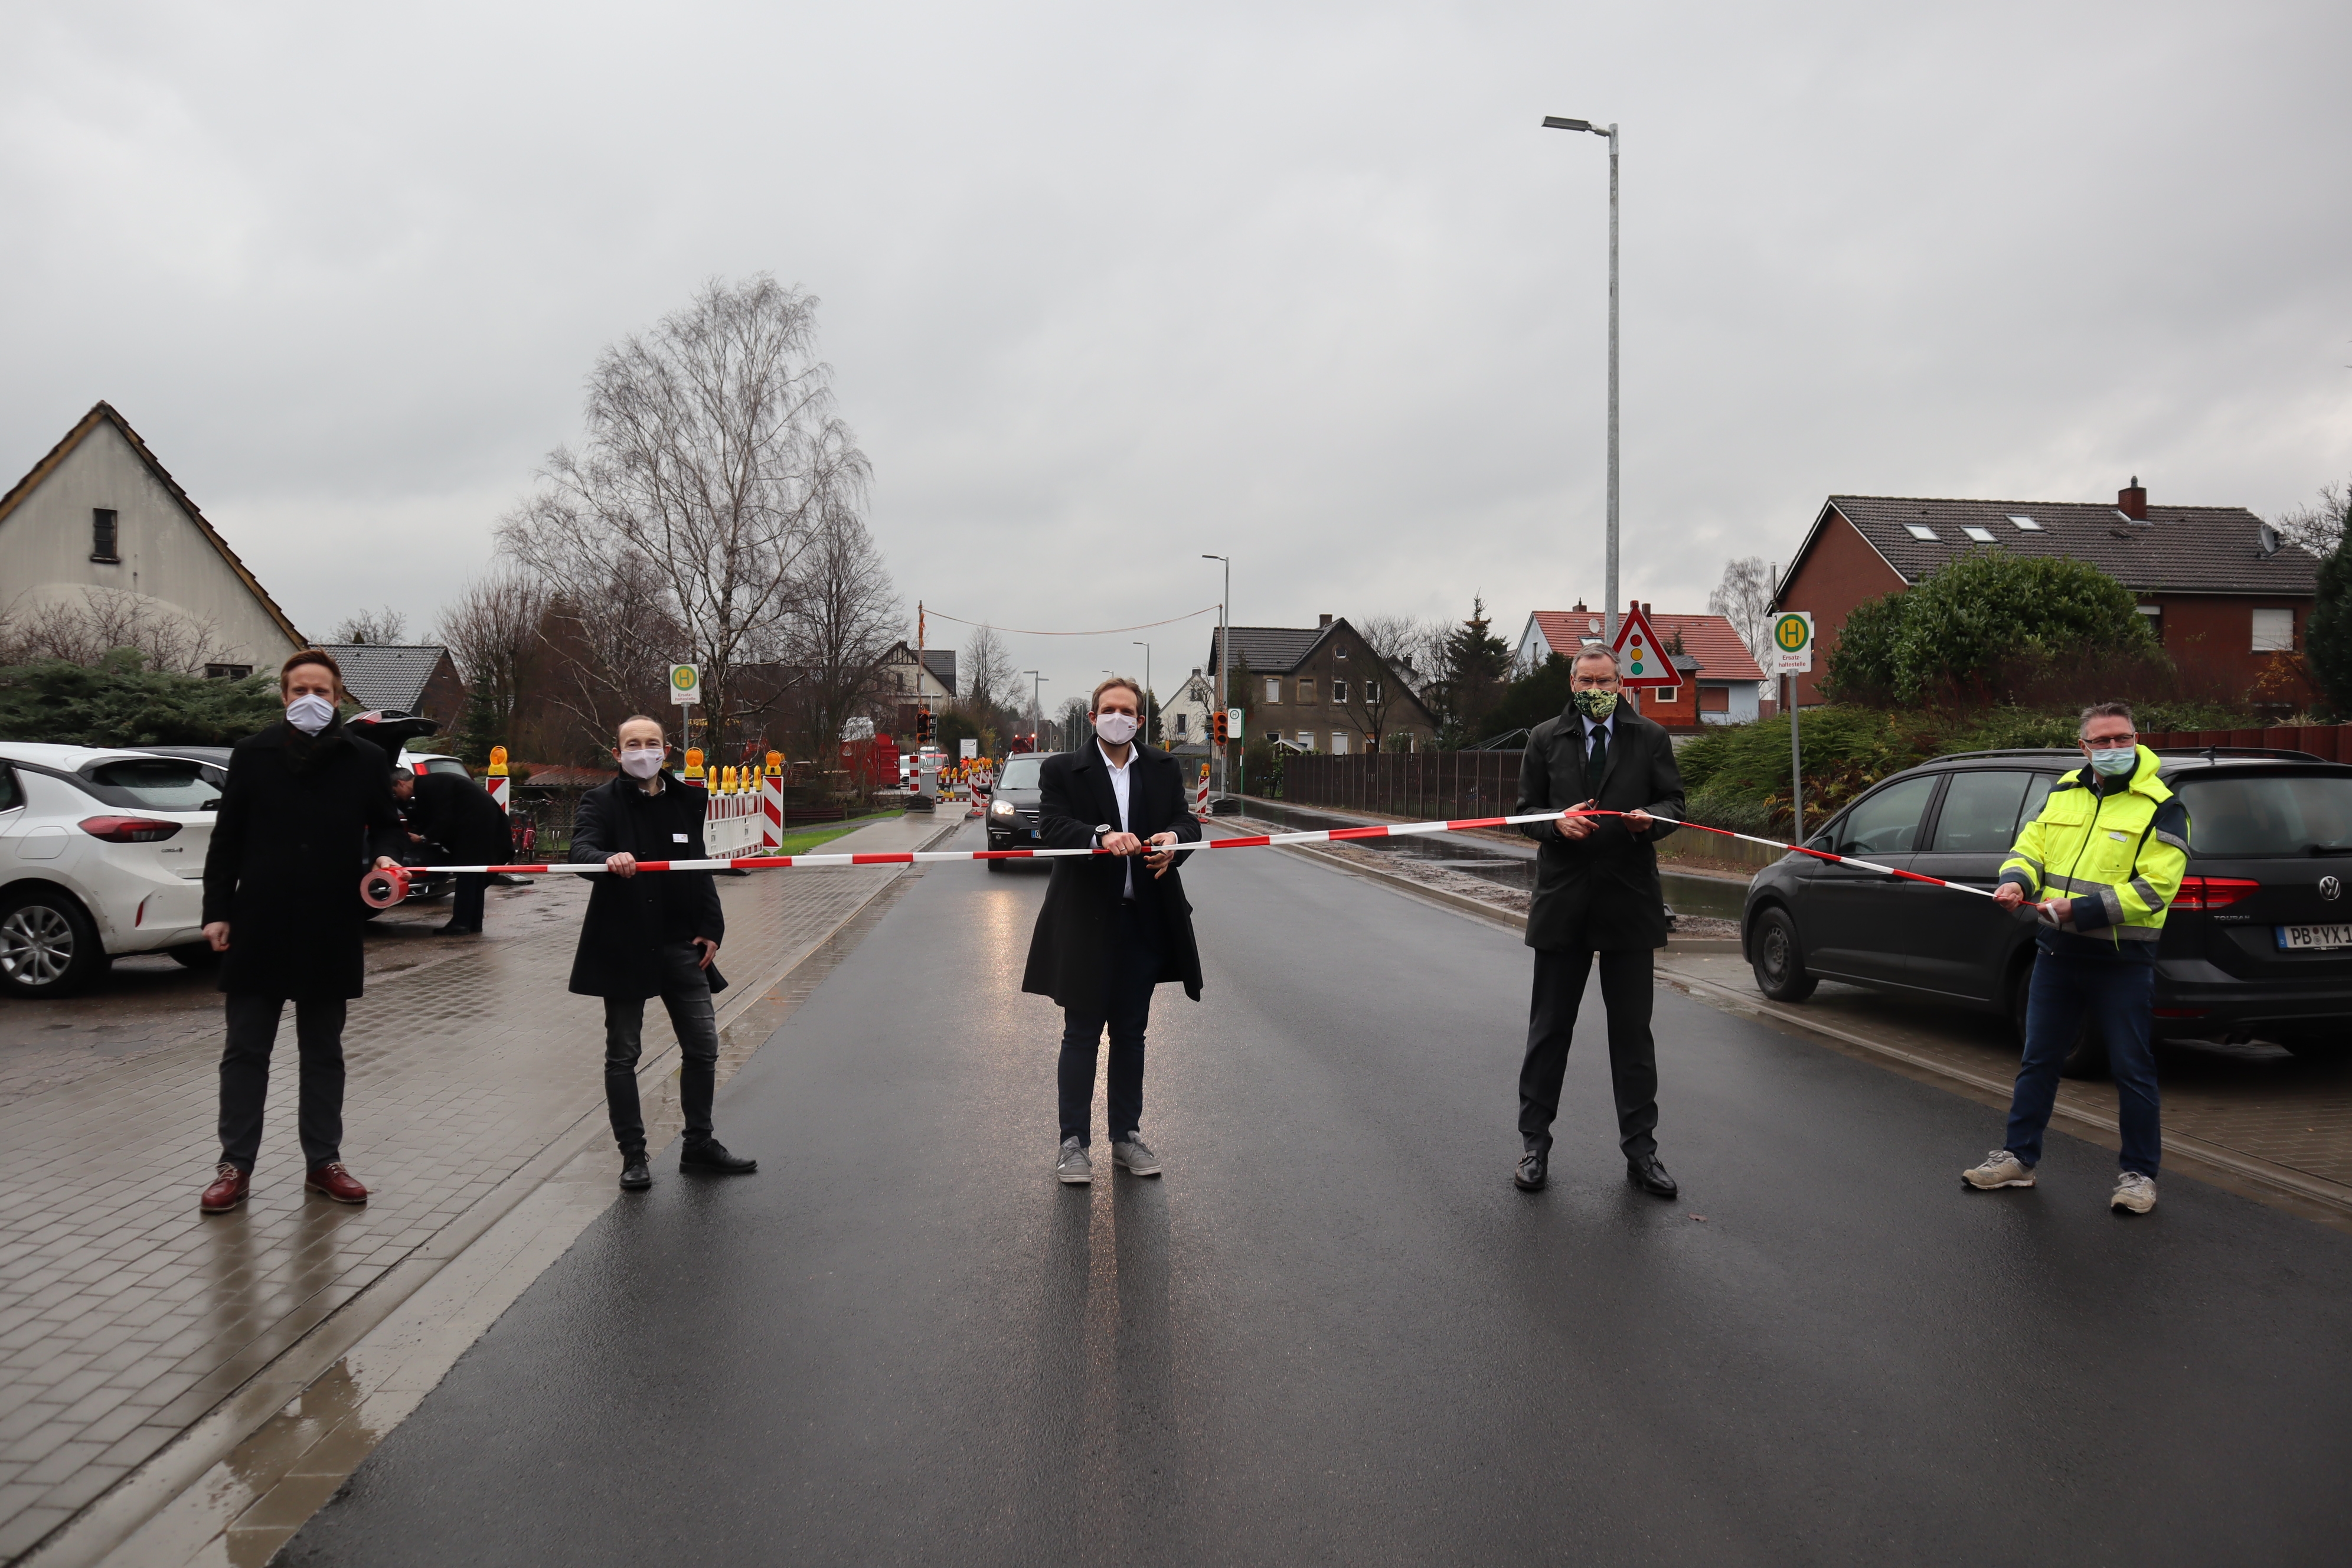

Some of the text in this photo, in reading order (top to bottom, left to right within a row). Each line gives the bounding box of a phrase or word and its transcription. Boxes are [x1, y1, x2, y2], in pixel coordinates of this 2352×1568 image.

[1785, 623, 1799, 643] H
[679, 671, 690, 685] H
[2291, 927, 2312, 945] PB
